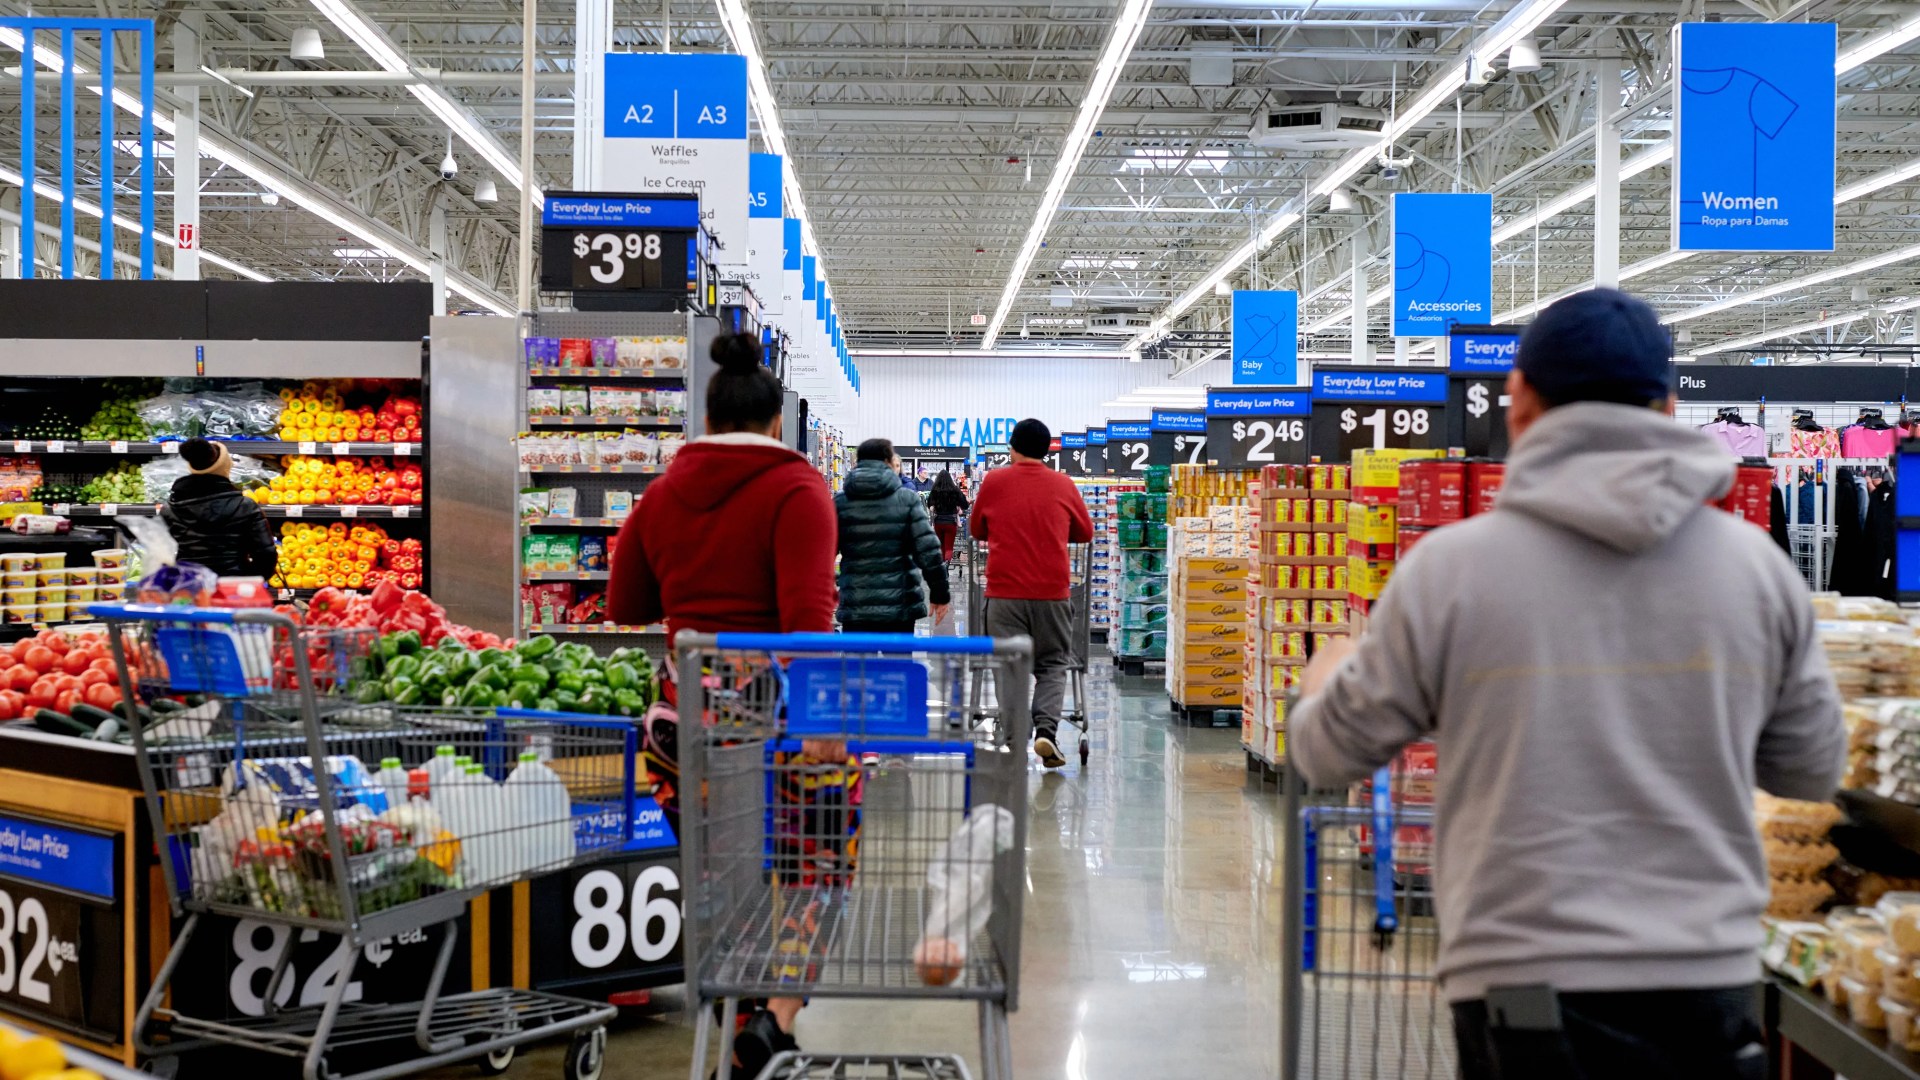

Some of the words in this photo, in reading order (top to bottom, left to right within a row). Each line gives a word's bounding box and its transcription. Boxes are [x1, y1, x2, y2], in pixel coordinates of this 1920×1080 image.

[623, 104, 654, 124] A2
[697, 105, 727, 125] A3
[651, 145, 698, 156] Waffles
[643, 176, 661, 187] Ice
[665, 176, 706, 187] Cream
[748, 192, 768, 207] A5
[1702, 191, 1778, 210] Women
[552, 202, 600, 215] Everyday
[602, 203, 623, 213] Low
[625, 203, 652, 214] Price
[1702, 216, 1727, 228] Ropa
[1730, 218, 1752, 228] para
[1755, 216, 1789, 226] Damas
[728, 271, 760, 280] Snacks
[1408, 299, 1482, 311] Accessories
[1242, 360, 1263, 370] Baby
[1323, 375, 1372, 389] Everyday
[1375, 377, 1396, 388] Low
[1398, 377, 1426, 388] Price
[1680, 376, 1706, 388] Plus
[1214, 399, 1253, 410] Everyday
[1254, 399, 1272, 408] Low
[1273, 399, 1295, 407] Price
[1158, 414, 1189, 424] Everyday
[1190, 415, 1204, 423] Low
[919, 417, 1018, 447] CREAMER
[1112, 426, 1138, 435] Everyday
[21, 829, 41, 852] Low
[42, 834, 70, 859] Price
[571, 866, 682, 969] 86
